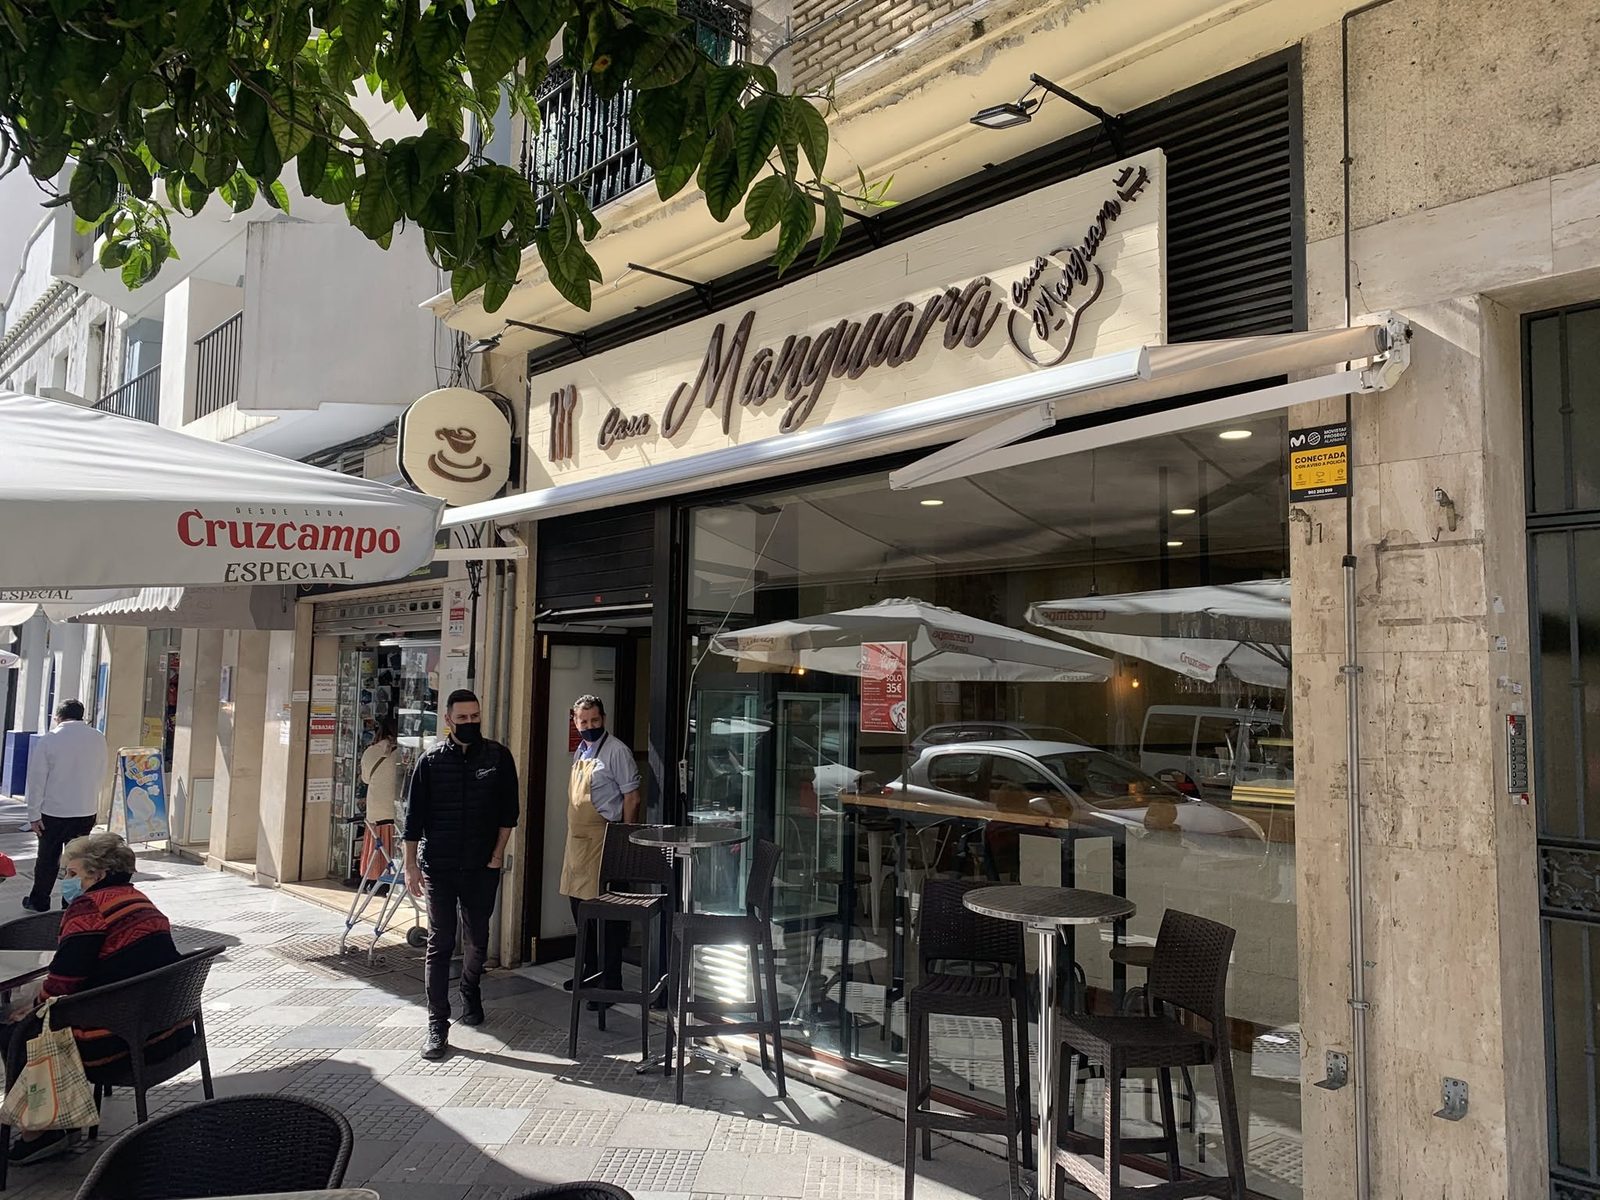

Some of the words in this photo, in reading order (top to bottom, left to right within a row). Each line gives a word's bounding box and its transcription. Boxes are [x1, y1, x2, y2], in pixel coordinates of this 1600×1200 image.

[1032, 200, 1121, 341] Manguara
[1012, 256, 1048, 308] Casa
[597, 407, 650, 450] Casa
[662, 276, 1001, 435] Manguara
[1295, 452, 1346, 464] CONECTADA
[236, 507, 288, 516] DESDE
[304, 509, 344, 517] 1904
[177, 508, 400, 559] Cruzcampo
[224, 561, 354, 583] ESPECIAL
[0, 590, 73, 600] ESPECIAL
[886, 674, 902, 682] SOLO
[886, 683, 902, 693] 35€
